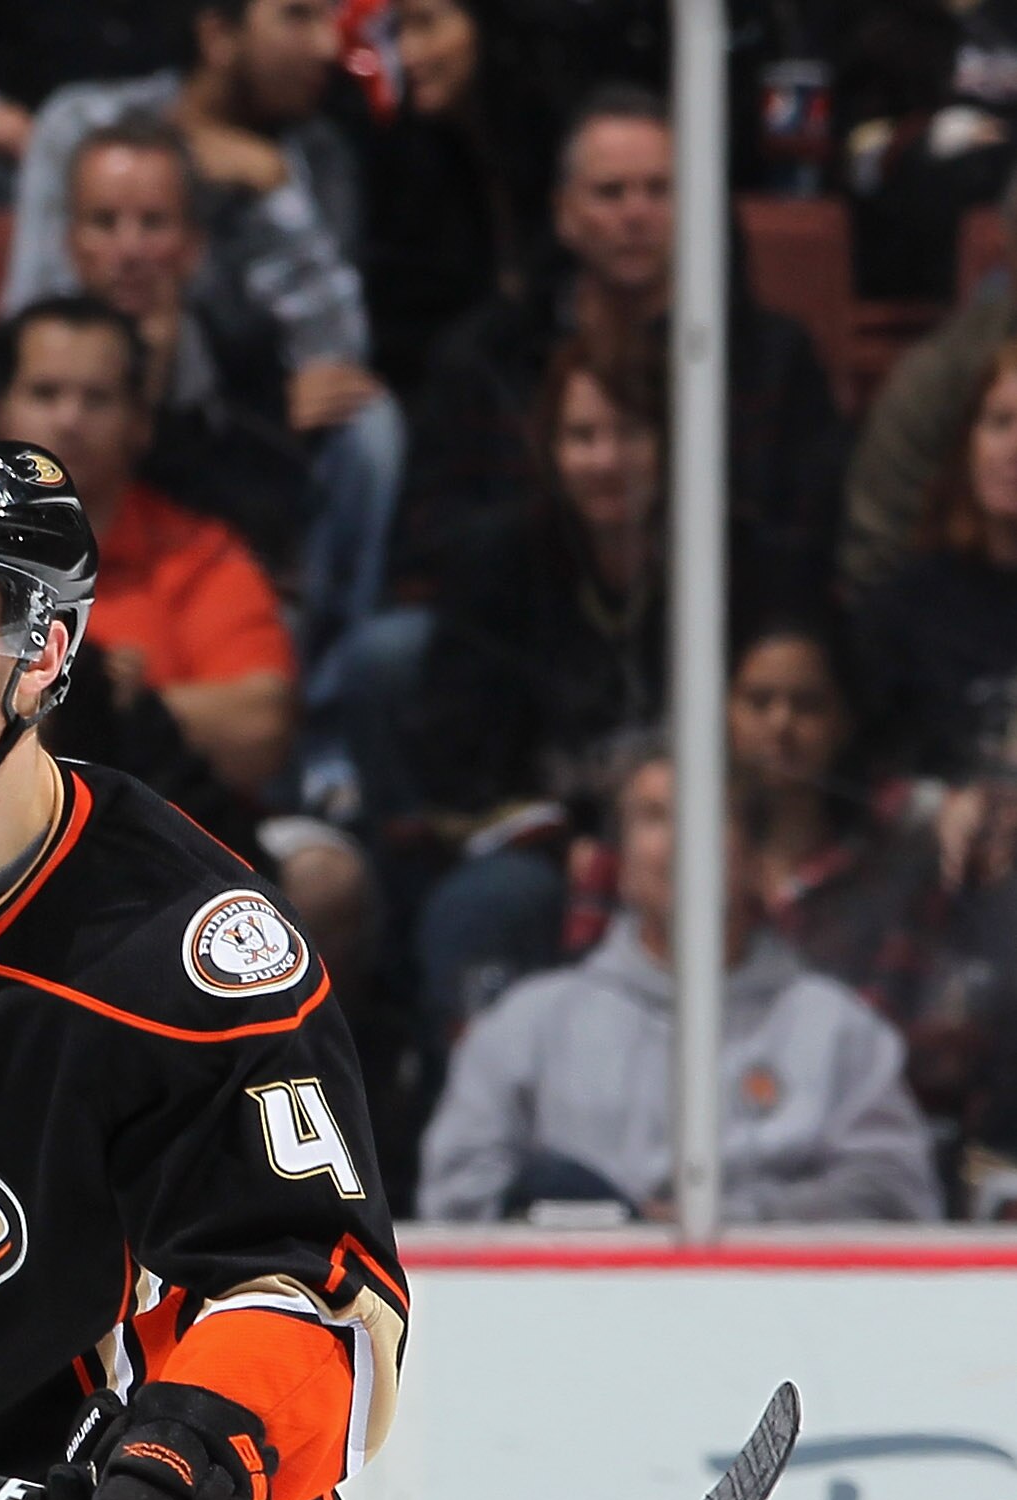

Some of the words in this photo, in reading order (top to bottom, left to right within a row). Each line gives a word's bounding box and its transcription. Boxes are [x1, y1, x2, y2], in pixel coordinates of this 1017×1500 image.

[199, 901, 275, 957] ANAHEIM
[239, 952, 296, 984] DUCKS
[245, 1077, 366, 1200] 4
